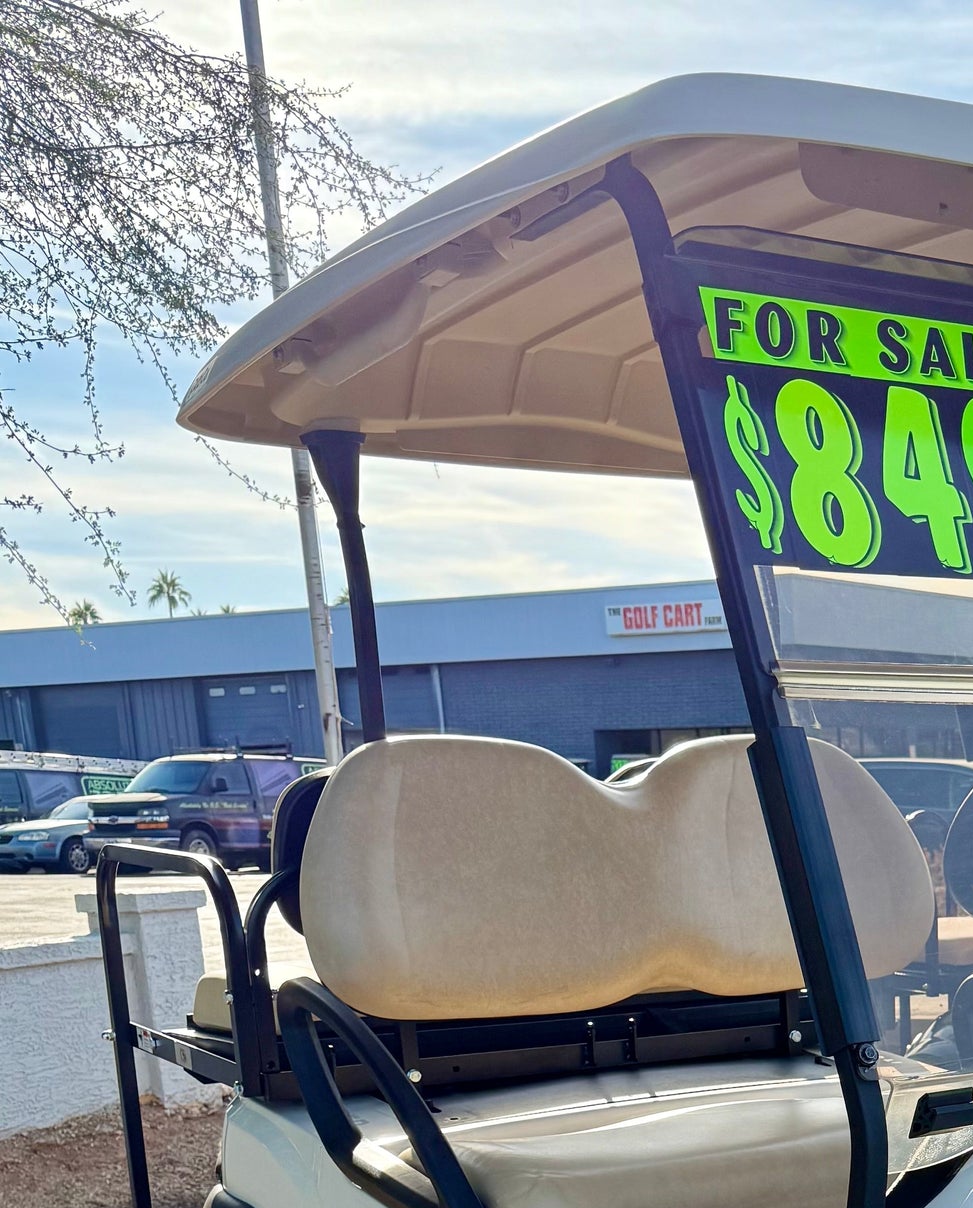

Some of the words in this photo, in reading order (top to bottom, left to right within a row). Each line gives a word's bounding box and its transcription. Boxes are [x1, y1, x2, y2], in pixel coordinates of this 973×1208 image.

[713, 296, 847, 366] FOR
[608, 607, 621, 617] THE
[622, 605, 658, 630] GOLF
[662, 602, 703, 628] CART
[704, 615, 723, 626] FARM
